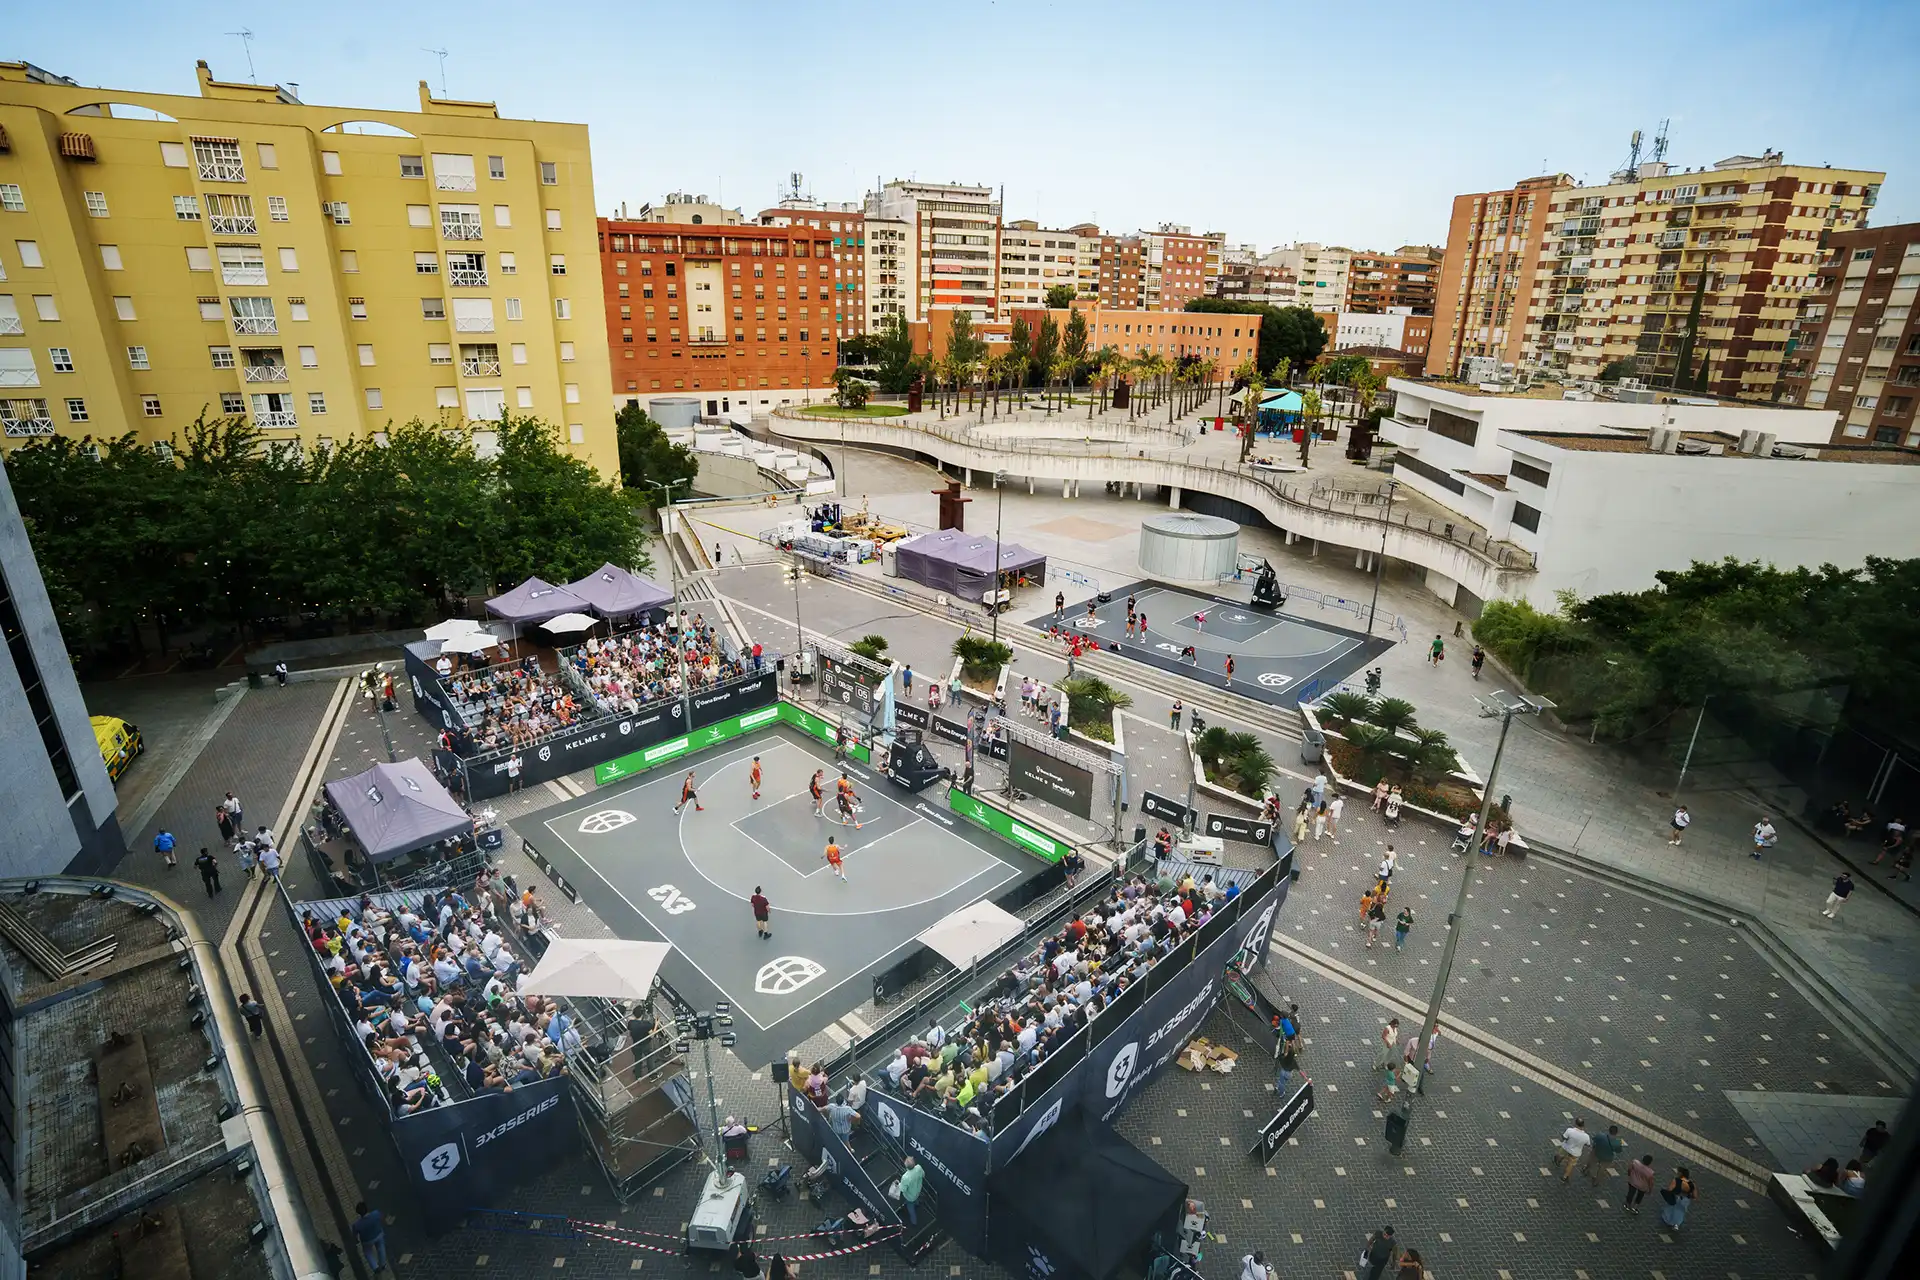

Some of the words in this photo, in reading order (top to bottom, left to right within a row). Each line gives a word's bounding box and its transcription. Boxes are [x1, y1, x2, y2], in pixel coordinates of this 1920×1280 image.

[565, 734, 599, 750] KELME
[1024, 770, 1043, 783] KELME
[806, 963, 821, 974] FEB
[1145, 977, 1214, 1050] 3X3SERIES
[475, 1094, 559, 1148] 3X3SERIES
[1040, 1106, 1058, 1127] FEB
[909, 1137, 972, 1196] 3X3SERIES
[843, 1176, 886, 1222] 3X3SERIES
